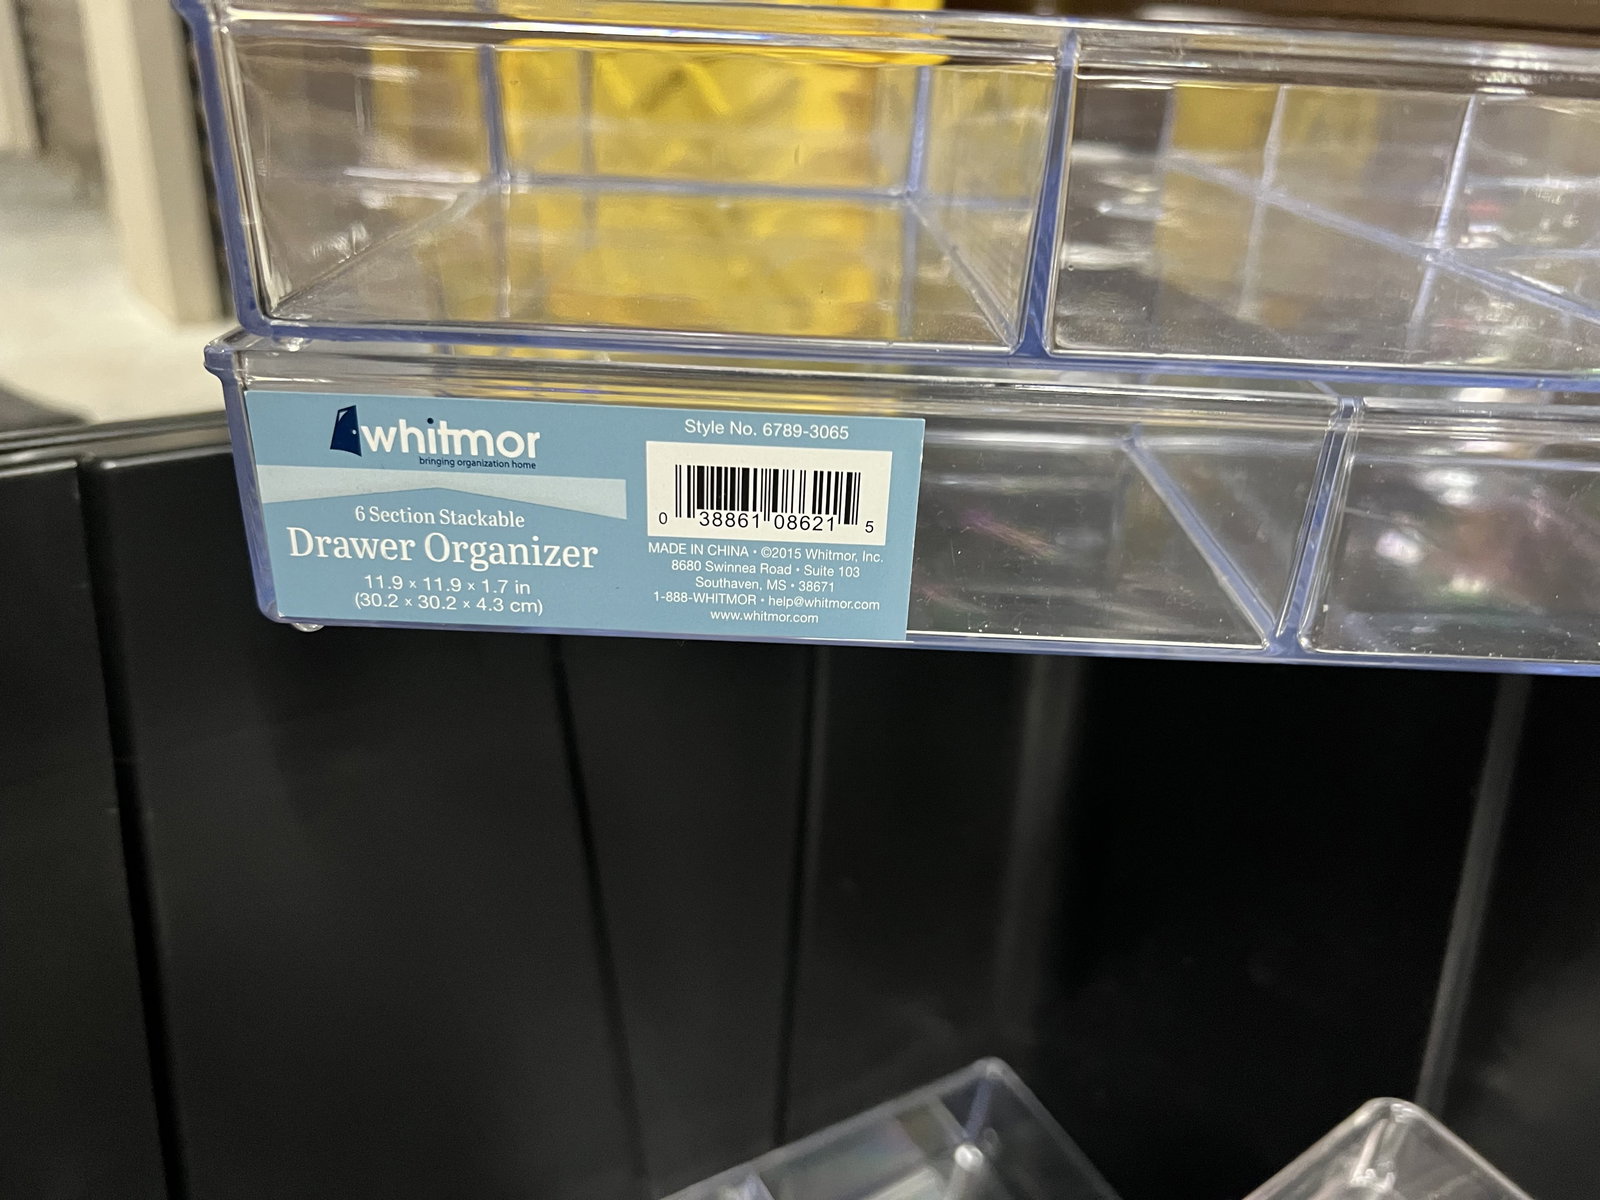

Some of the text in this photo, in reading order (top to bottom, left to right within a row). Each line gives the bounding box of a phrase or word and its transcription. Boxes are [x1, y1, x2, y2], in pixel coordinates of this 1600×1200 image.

[361, 418, 541, 458] whitmor
[684, 419, 849, 440] Style No. 6789-3065
[419, 456, 536, 470] bringing organization home
[355, 506, 525, 528] 6 Section Stackable
[658, 512, 874, 533] 0 38861 08621 5
[286, 527, 598, 572] Drawer Organizer
[648, 542, 686, 554] MADE
[690, 543, 704, 555] IN
[707, 544, 749, 558] CHINA
[804, 548, 858, 562] Whitmor,
[862, 550, 884, 562] Inc.
[671, 560, 860, 578] 8680 Swinnea Road Suite 103
[364, 574, 403, 590] 11.9
[422, 576, 462, 592] 11.9
[481, 579, 509, 594] 1.7
[515, 580, 531, 594] in
[695, 576, 834, 592] Southaven, MS 38671
[354, 592, 399, 609] (30.2
[418, 594, 458, 610] 30.2
[476, 596, 504, 611] 4.3
[510, 599, 543, 616] cm)
[654, 591, 880, 610] 1-888-WHITMOR help@whitmor.com
[710, 610, 819, 624] www.whitmor.com
